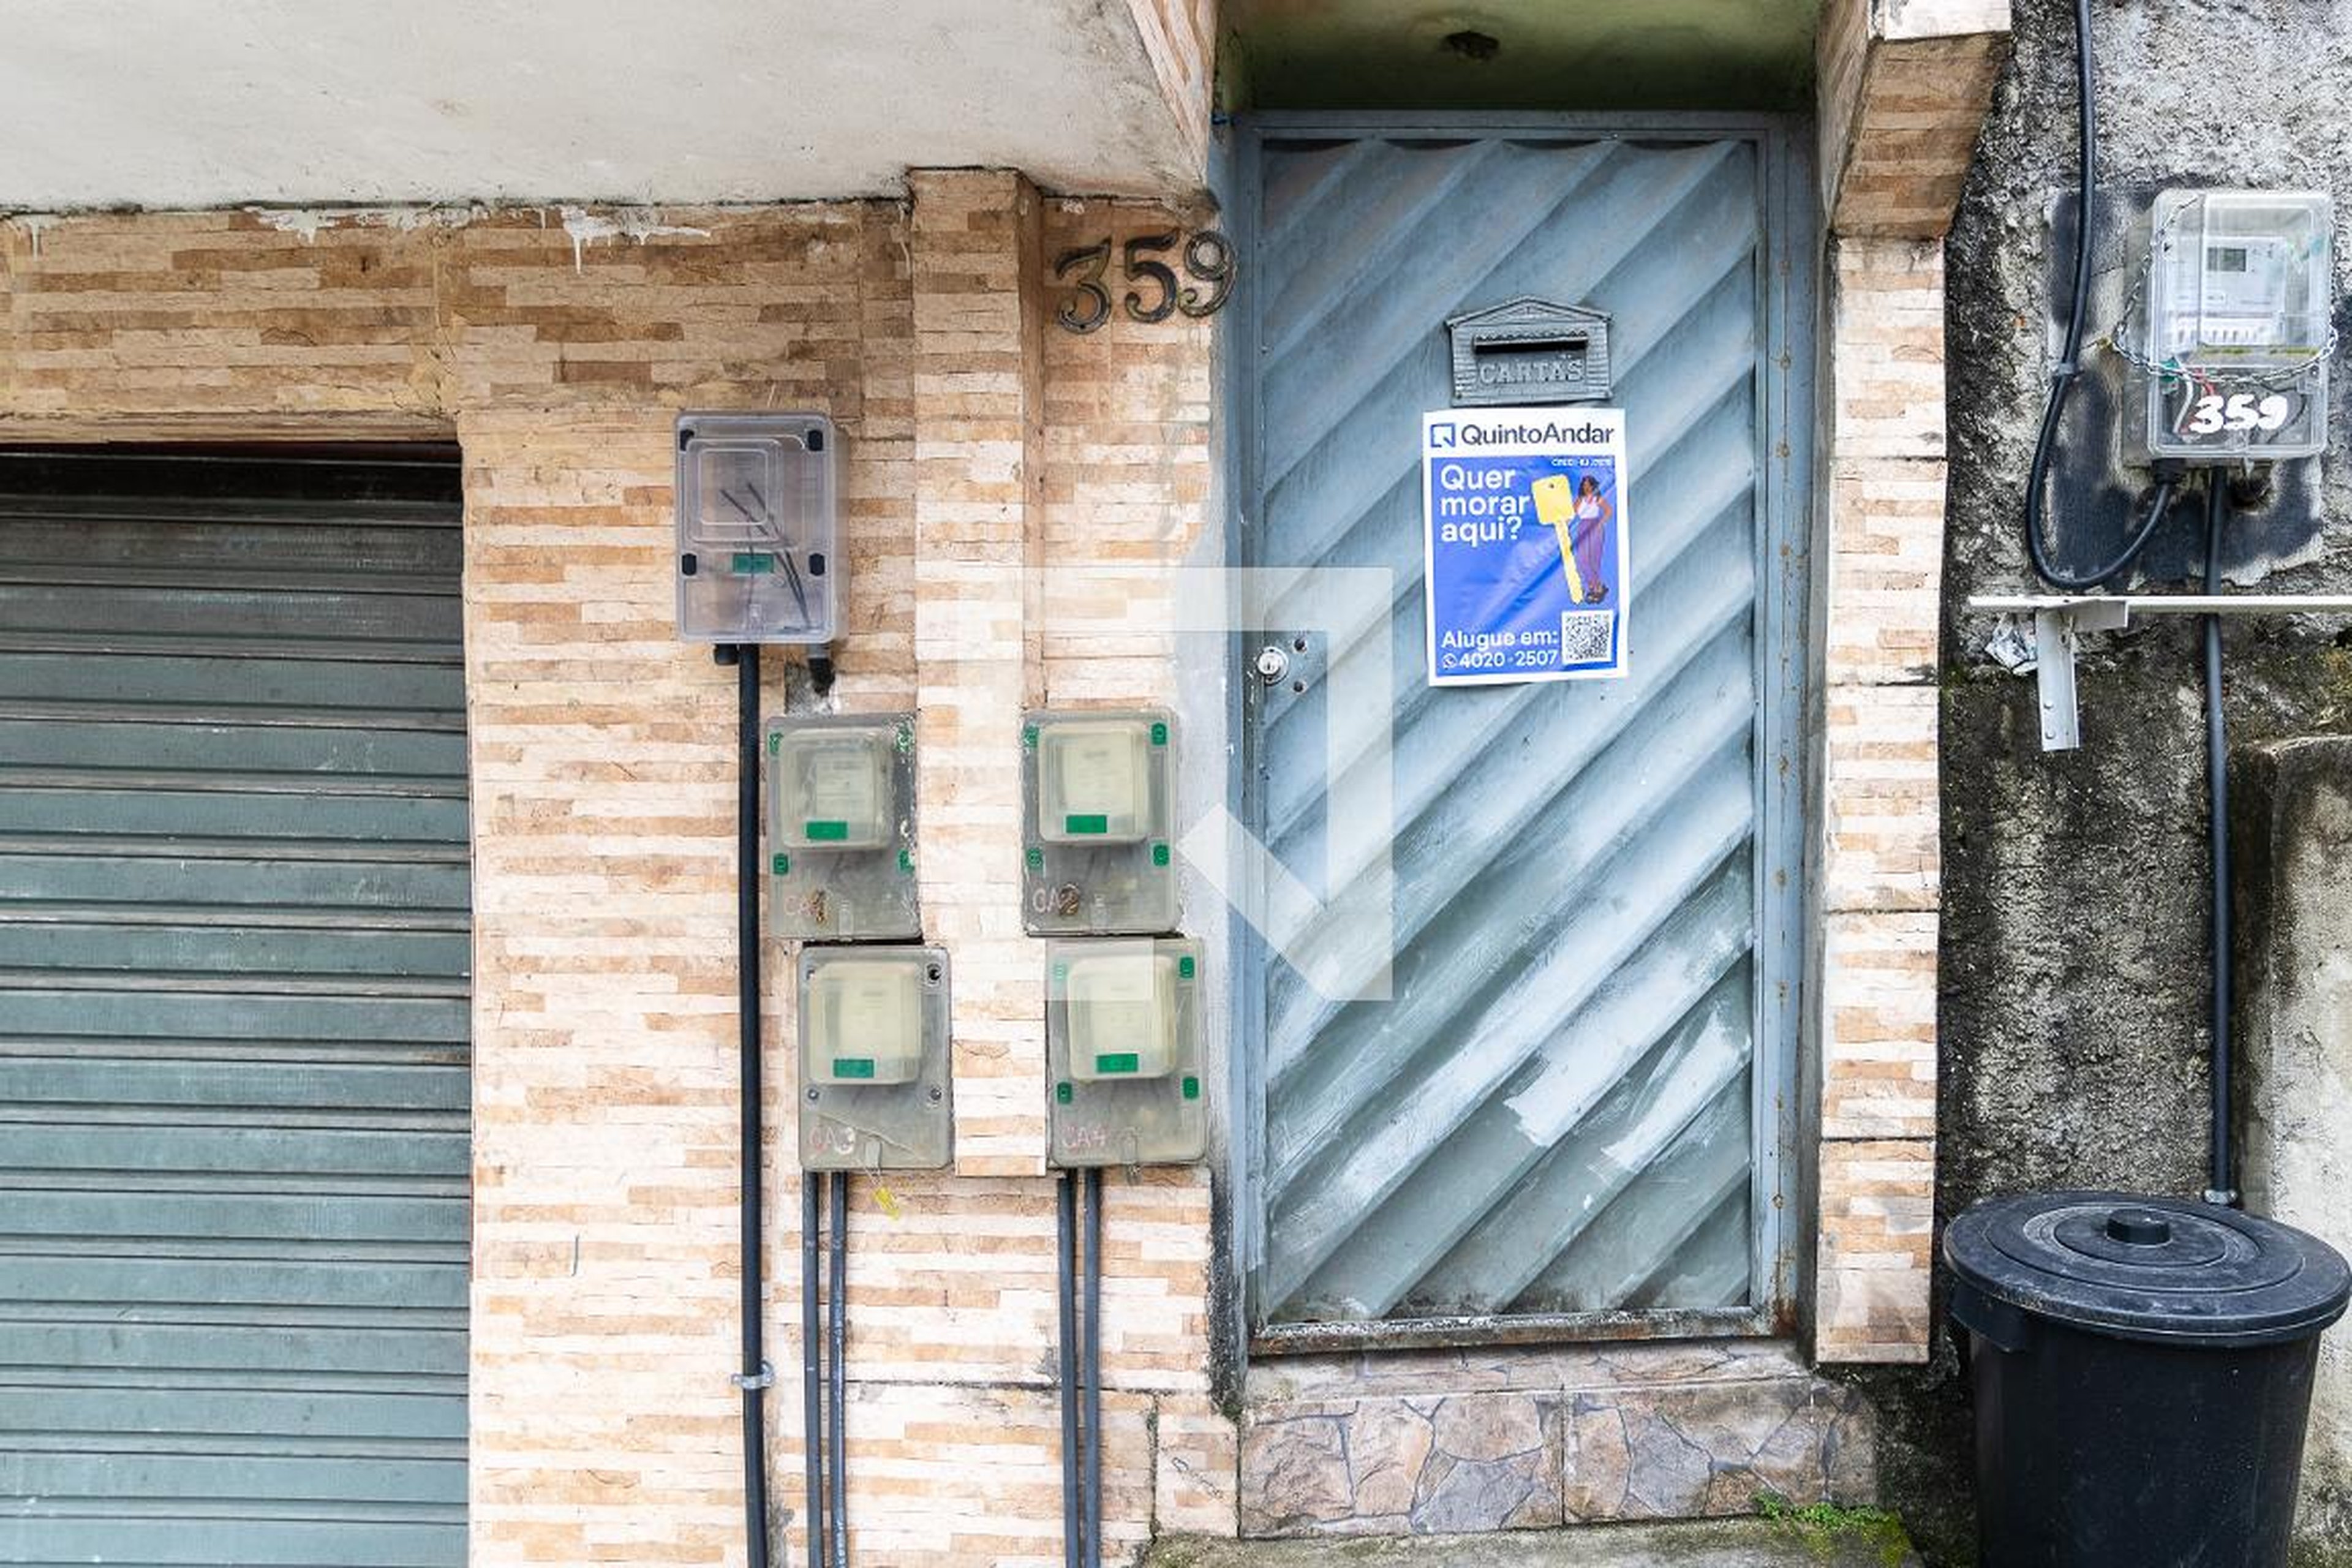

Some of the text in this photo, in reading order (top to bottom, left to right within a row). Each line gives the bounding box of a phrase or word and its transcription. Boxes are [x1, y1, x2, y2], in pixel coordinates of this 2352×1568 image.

[1054, 227, 1238, 334] 359
[1479, 358, 1585, 385] CARTAS
[2189, 393, 2288, 434] 359
[1461, 422, 1615, 446] QuintoAndar
[1441, 464, 1517, 491] Quer
[1441, 495, 1531, 516] morar
[1441, 516, 1523, 548] aqui?
[1441, 630, 1558, 651] Alugue em:
